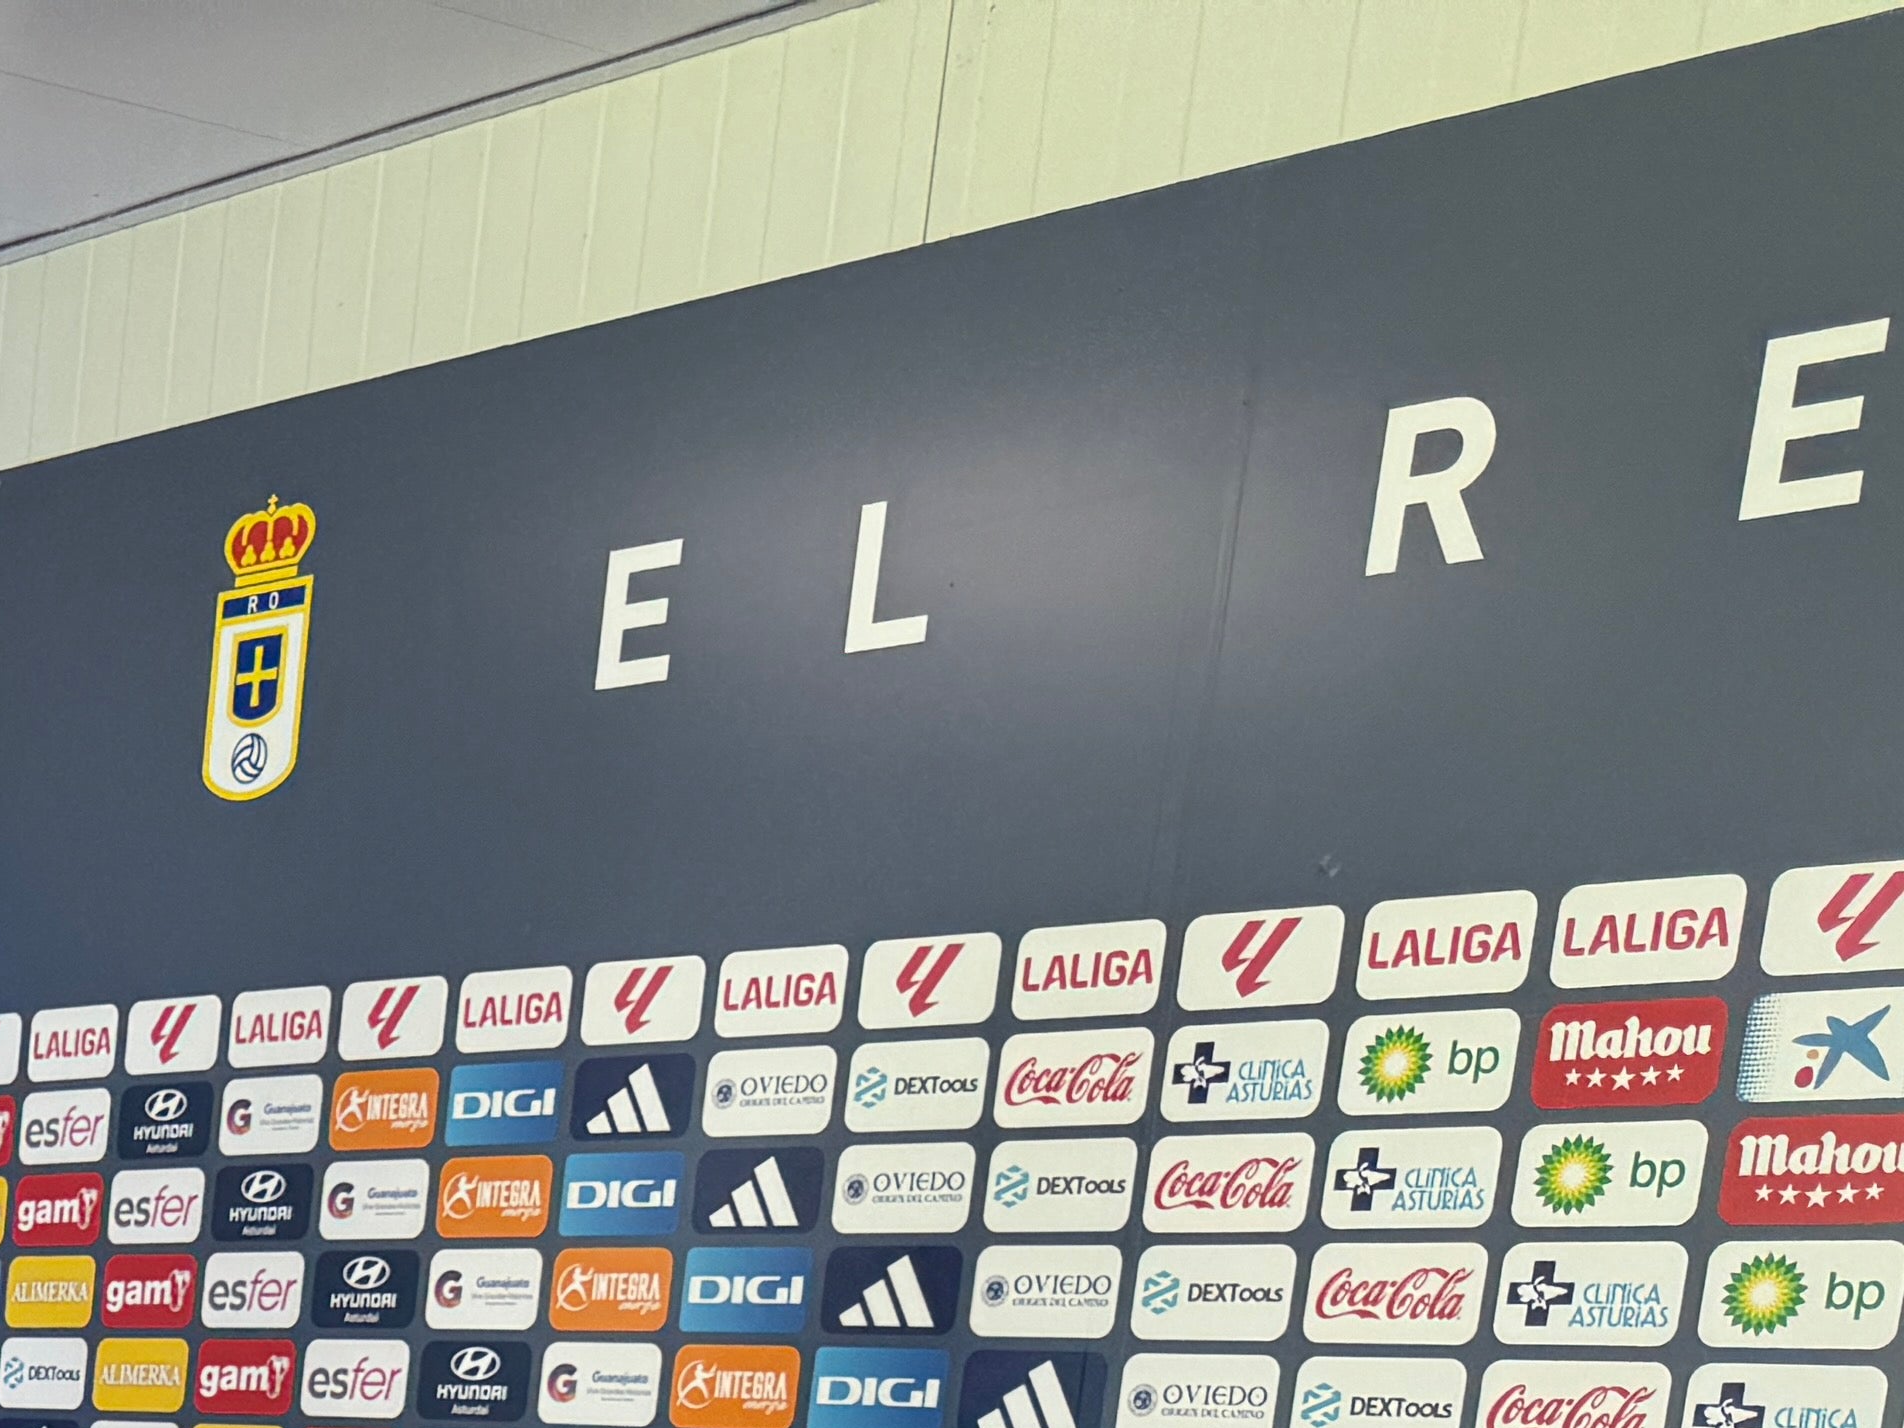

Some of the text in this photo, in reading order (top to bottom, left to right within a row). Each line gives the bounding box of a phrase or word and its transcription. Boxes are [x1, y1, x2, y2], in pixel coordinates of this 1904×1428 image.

[1367, 921, 1522, 970] LALIGA
[1563, 905, 1728, 957] LALIGA
[1021, 947, 1153, 992] LALIGA
[33, 1026, 111, 1059] LALIGA
[1549, 1015, 1712, 1062] Mahou
[1446, 1038, 1501, 1084] bp
[740, 1074, 828, 1096] OVIEDO
[451, 1087, 556, 1120] DIGI
[24, 1105, 104, 1149] esfer
[133, 1123, 193, 1140] HYUNDAI
[873, 1171, 965, 1192] OVIEDO
[113, 1184, 198, 1228] esfer
[228, 1206, 292, 1222] HYUNDAI
[10, 1281, 89, 1303] ALIMERKA
[686, 1276, 805, 1304] DIGI
[1824, 1271, 1885, 1321] bp
[307, 1356, 402, 1400] esfer
[436, 1383, 507, 1401] HYUNDAI
[815, 1376, 941, 1408] DIGI
[1162, 1384, 1269, 1407] OVIEDO
